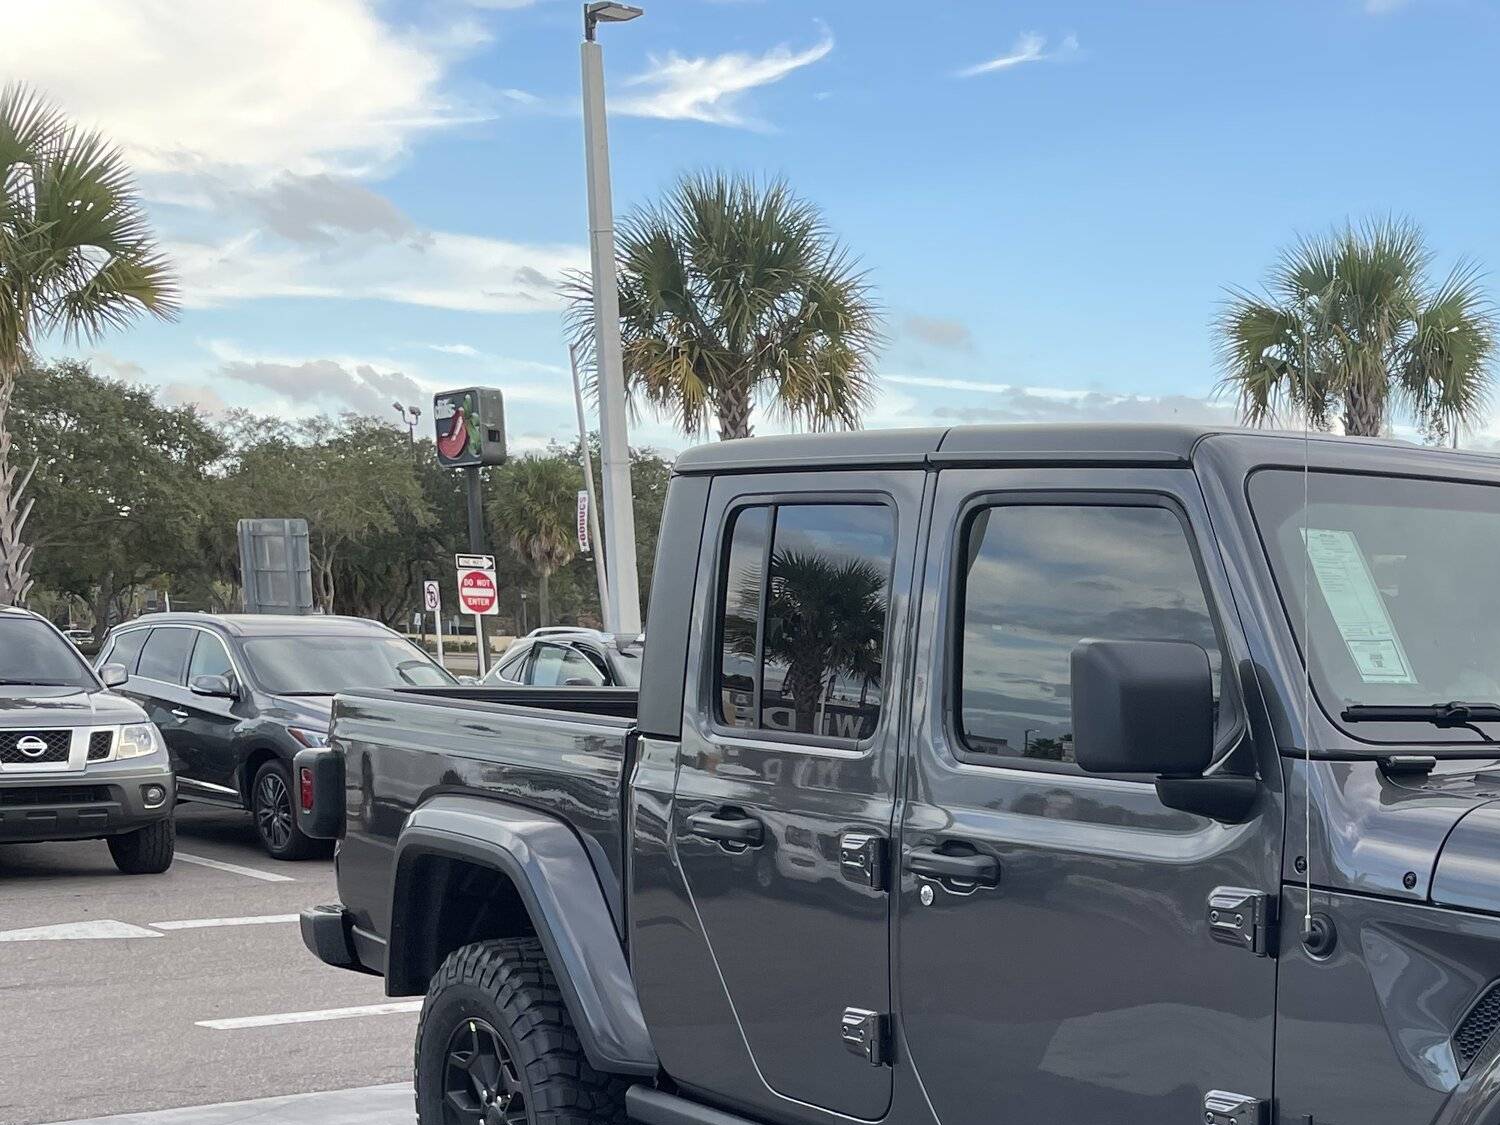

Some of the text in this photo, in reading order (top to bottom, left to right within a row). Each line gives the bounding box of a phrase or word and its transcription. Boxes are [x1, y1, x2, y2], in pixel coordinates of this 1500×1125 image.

[463, 578, 491, 588] DO NOT
[467, 597, 491, 606] ENTER
